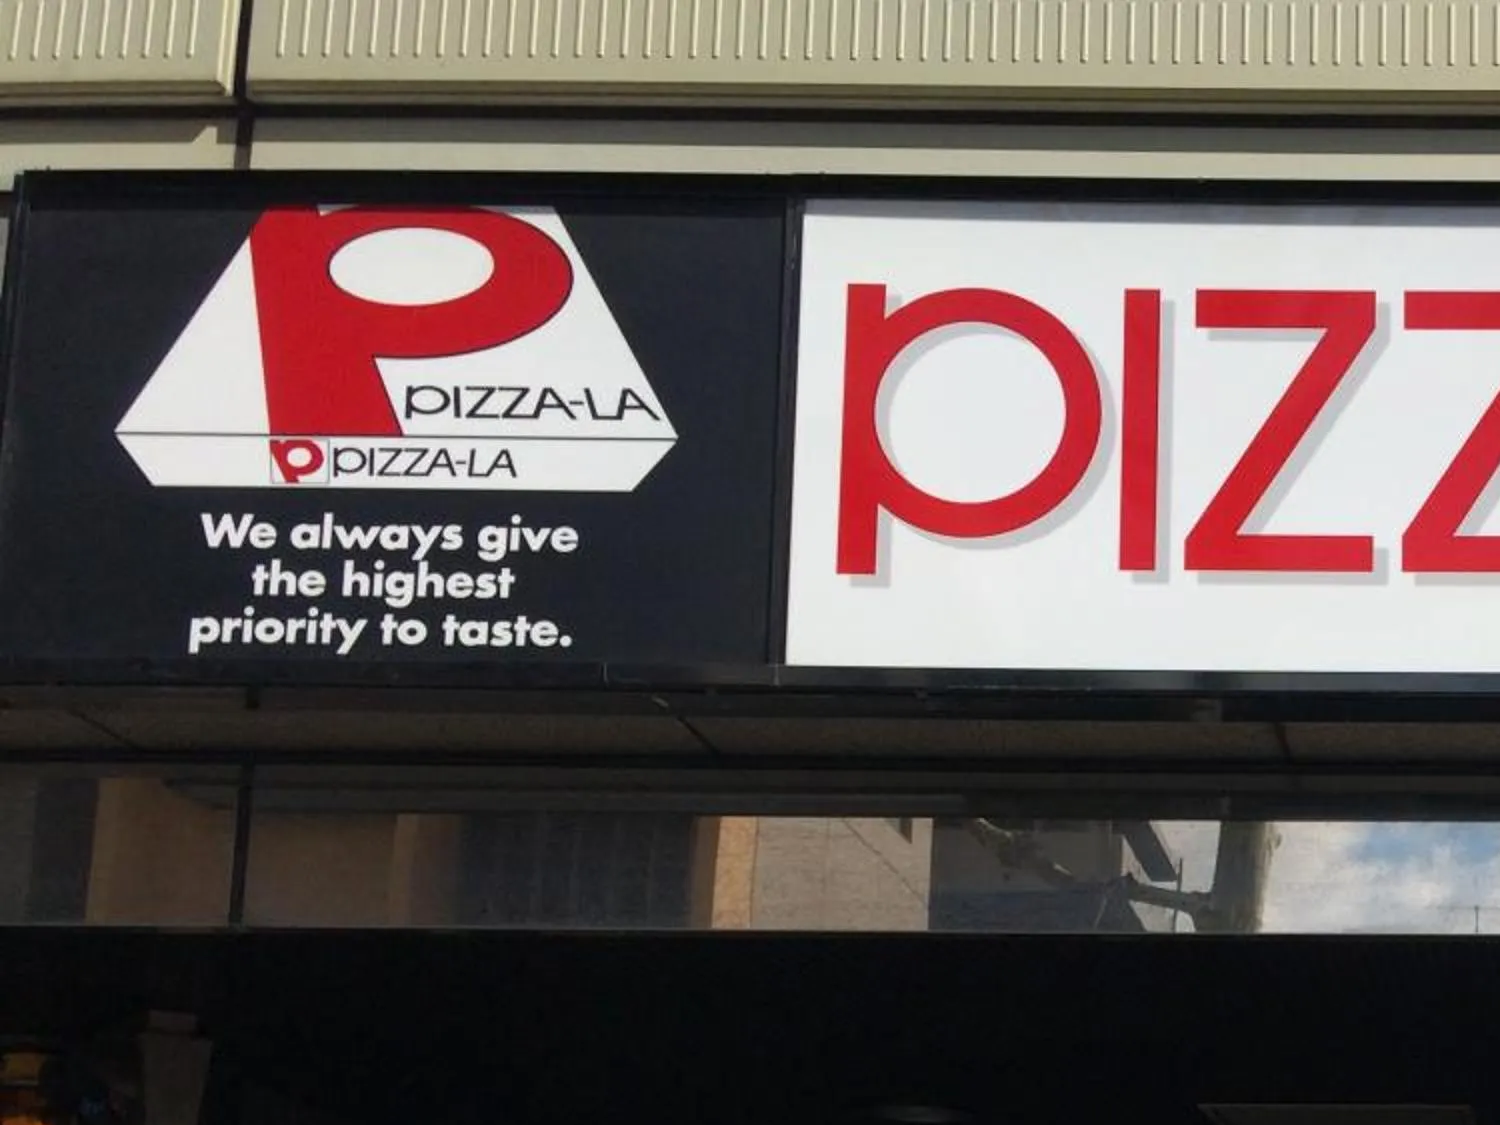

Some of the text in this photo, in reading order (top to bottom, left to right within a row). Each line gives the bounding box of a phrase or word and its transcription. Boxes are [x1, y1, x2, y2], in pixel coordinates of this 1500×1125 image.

[404, 385, 662, 421] PIZZA-LA
[333, 447, 518, 478] PIZZA-LA
[201, 512, 579, 561] We always give
[251, 561, 516, 608] the highest
[189, 607, 573, 654] priority to taste.
